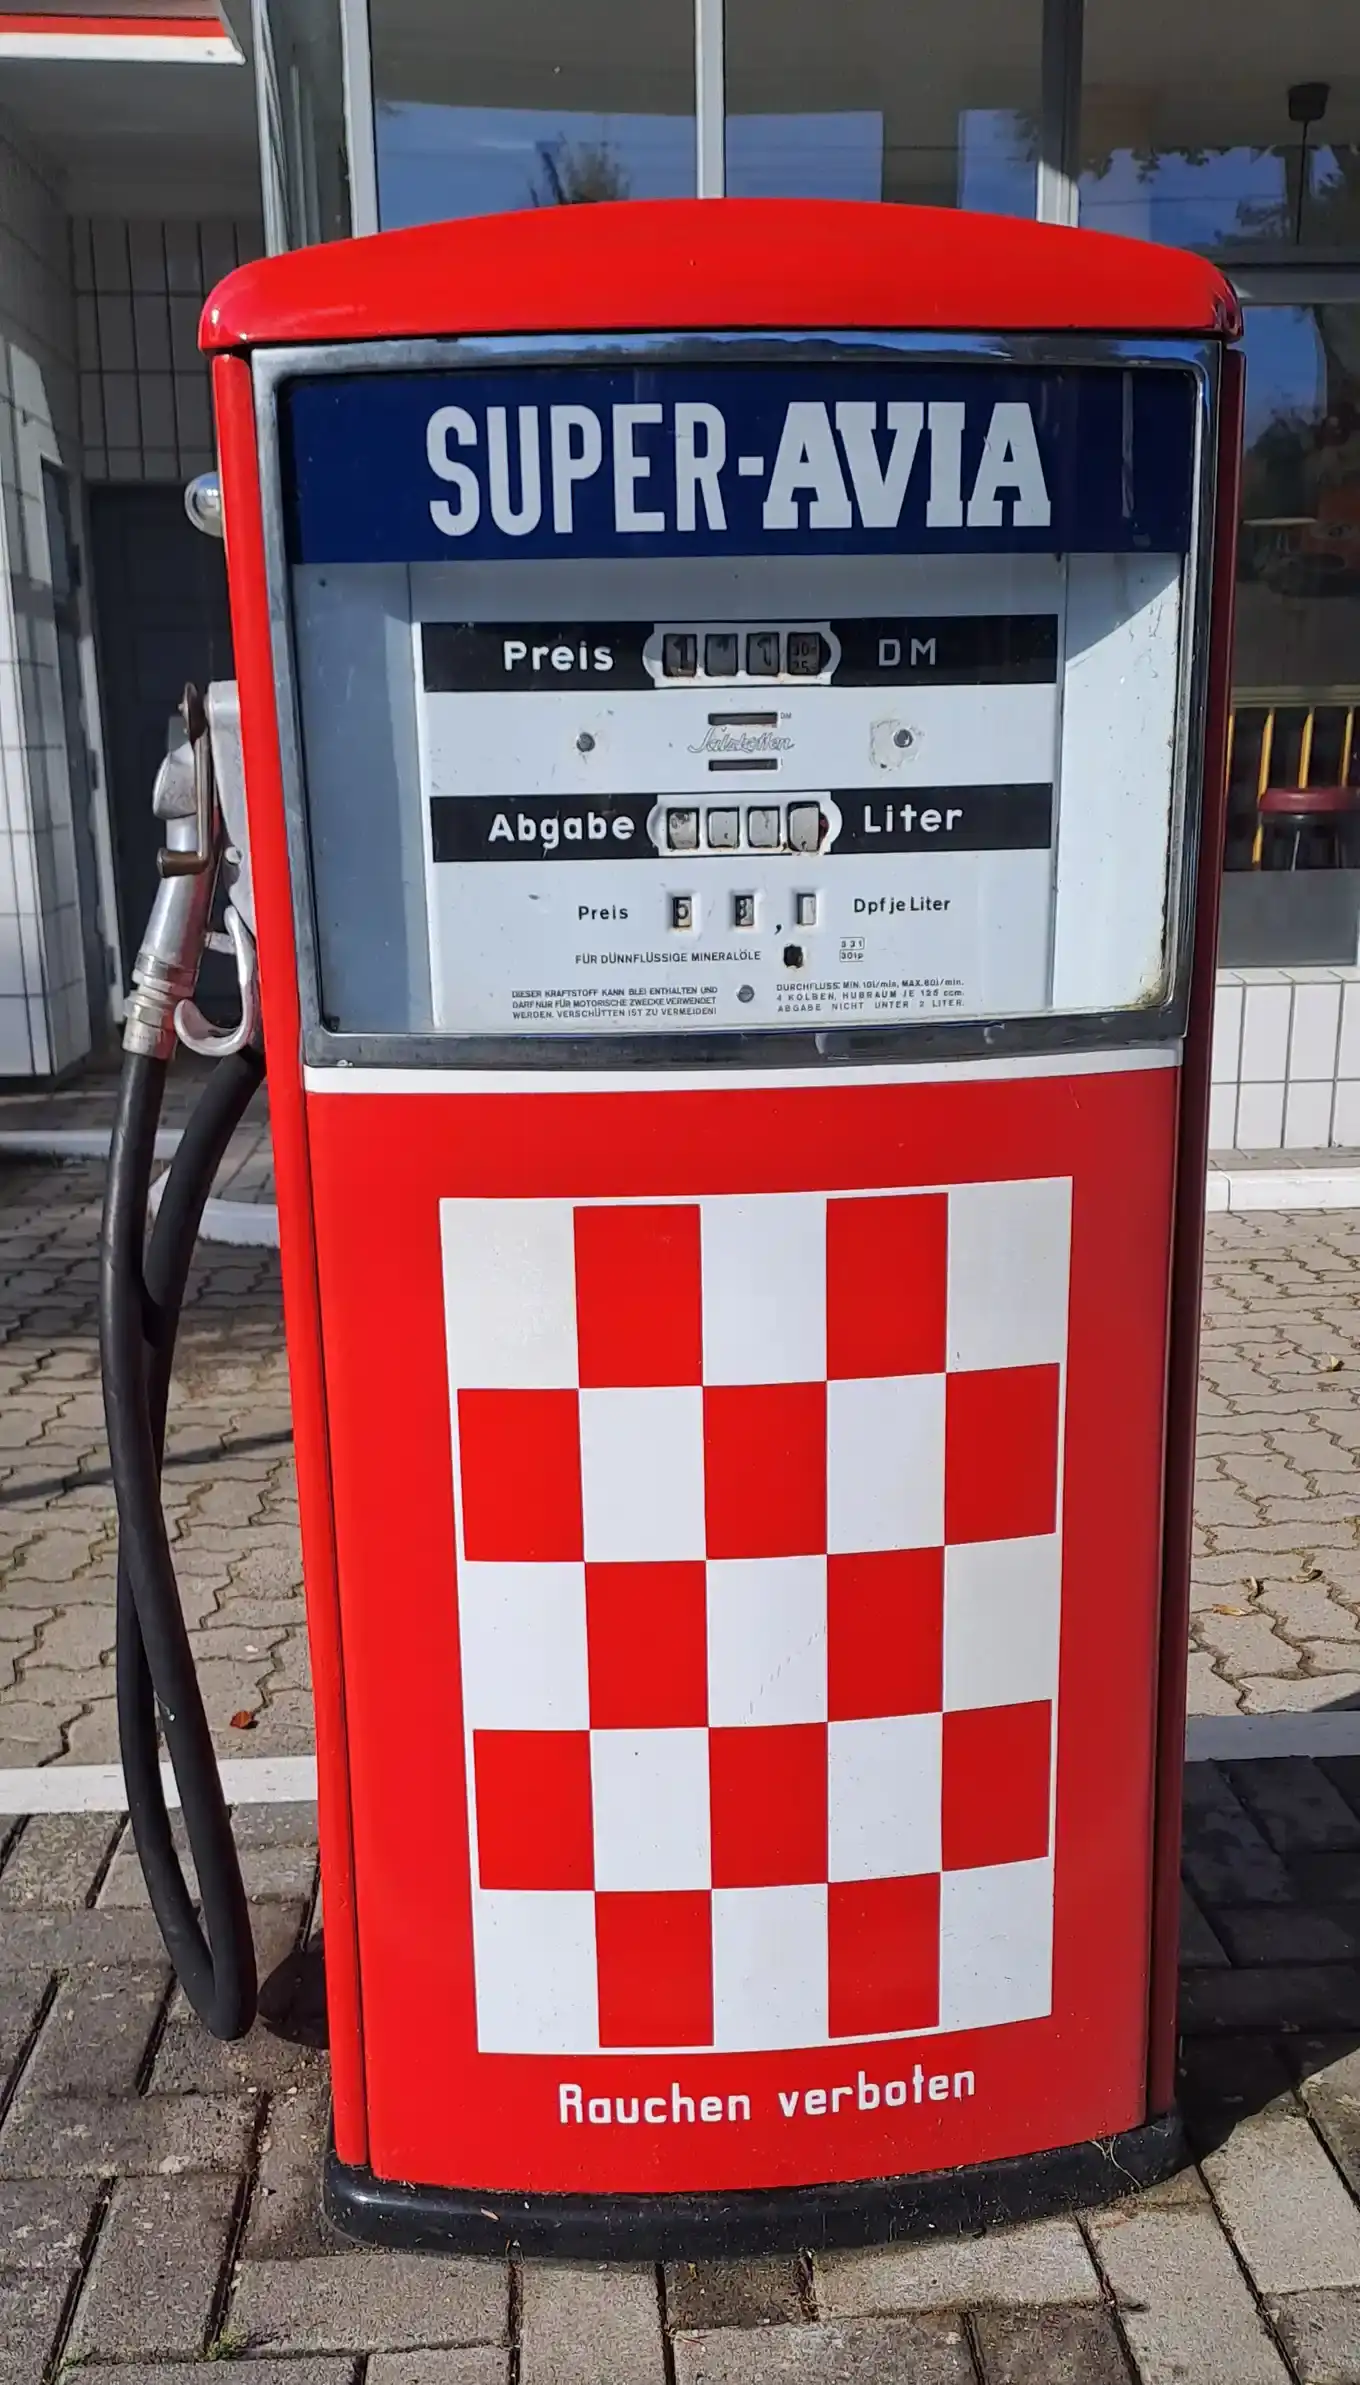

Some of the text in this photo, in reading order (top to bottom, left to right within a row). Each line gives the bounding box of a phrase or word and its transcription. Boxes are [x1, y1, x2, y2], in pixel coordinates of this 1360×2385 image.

[426, 401, 1052, 536] SUPER-AVIA
[502, 639, 615, 672] Preis
[878, 637, 938, 668] DM
[864, 804, 965, 833] Liter
[488, 813, 636, 850] Abgabe
[578, 905, 629, 921] Preis
[854, 896, 951, 915] Dpf je Liter
[575, 949, 761, 965] FÜR DÜNNFLÜSSIGE MINERALÖLE
[511, 986, 718, 999] DIESER KRAFTSTOFF KANN BLEI ENTHALTEN UND
[842, 990, 898, 1000] HUBRAUM
[902, 989, 915, 999] JE
[512, 996, 717, 1009] DARF NUR FÜR MOTORISCHE ZWECKE VERWENDET
[777, 1002, 823, 1013] ABGABE
[832, 1001, 865, 1012] NICHT
[874, 1000, 910, 1010] UNTER
[919, 1000, 926, 1009] 2
[557, 1008, 625, 1019] VERSCHÜTTEN
[628, 1008, 643, 1018] IST
[645, 1008, 658, 1017] ZU
[558, 2063, 976, 2124] Rauchen verboten
